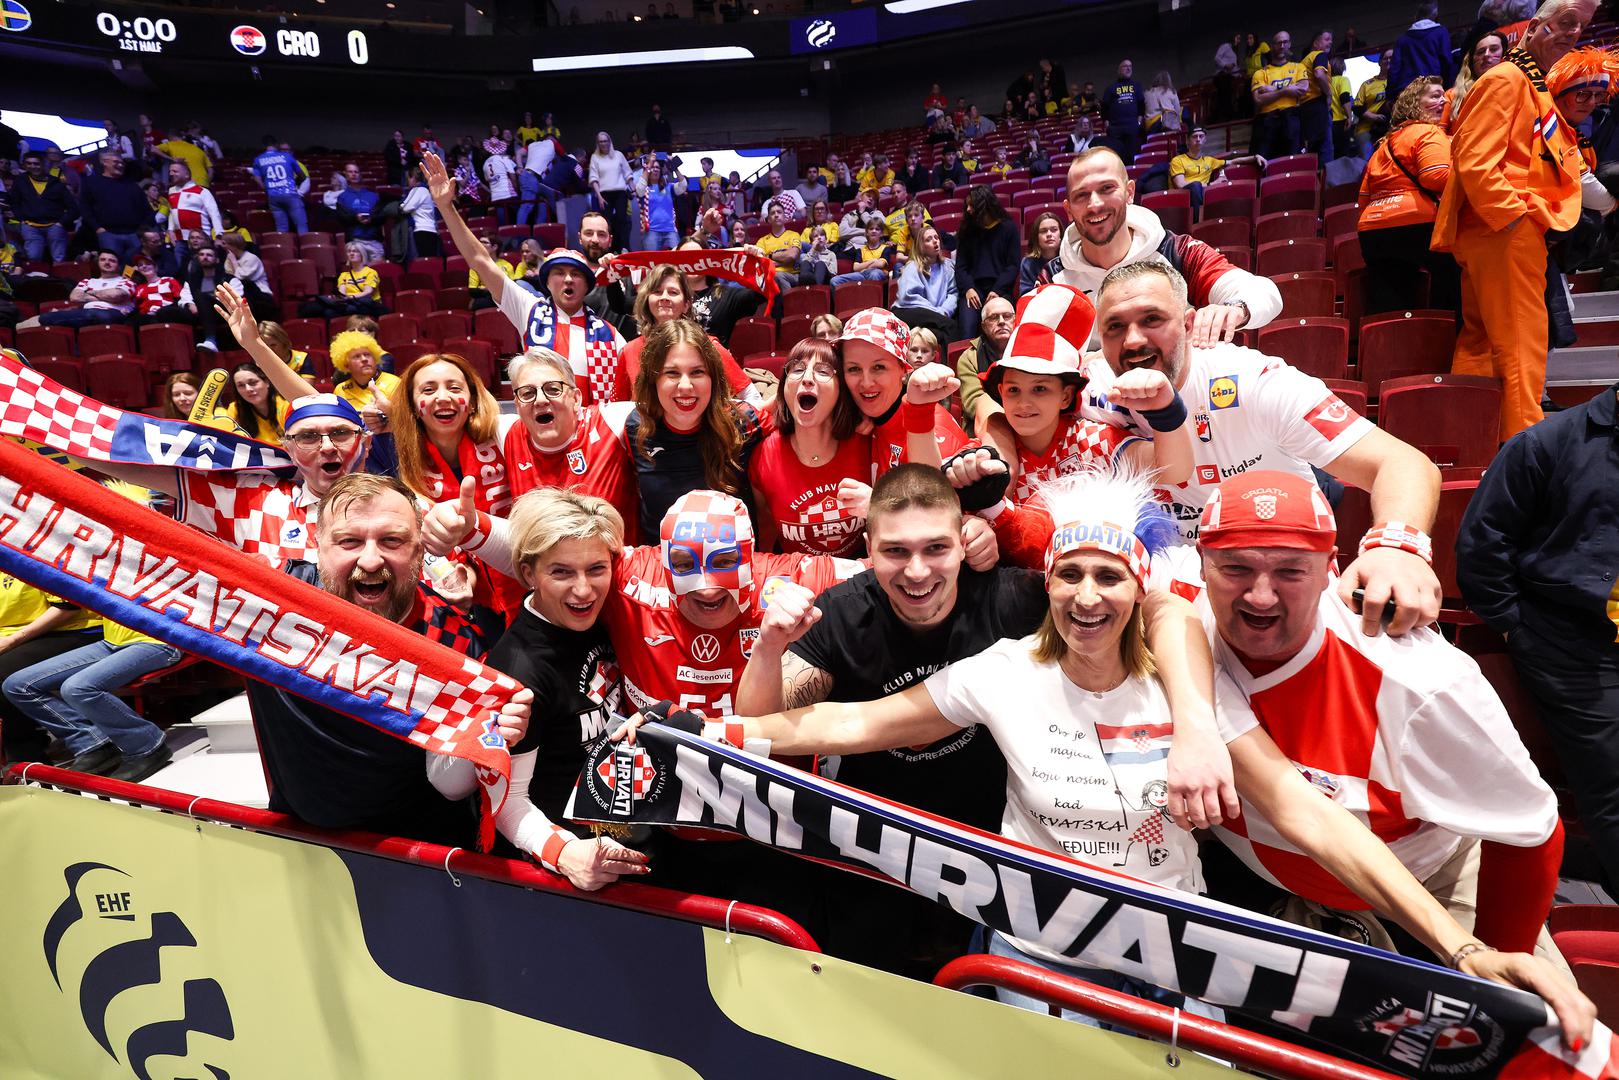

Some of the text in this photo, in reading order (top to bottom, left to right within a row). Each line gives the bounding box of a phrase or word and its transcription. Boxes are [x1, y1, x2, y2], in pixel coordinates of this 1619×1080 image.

[97, 12, 177, 42] 0:00
[119, 38, 162, 53] 1ST HALF
[276, 29, 369, 65] CRO 0
[1116, 85, 1135, 95] SWE
[266, 164, 288, 181] 40
[1211, 387, 1235, 398] LIDL
[1221, 453, 1263, 479] triglav
[789, 489, 815, 511] KLUB
[1240, 487, 1290, 501] CROATIA
[674, 520, 735, 544] CRO
[781, 522, 807, 542] MI
[1053, 524, 1133, 557] CROATIA
[0, 474, 420, 716] HRVATSKA
[579, 663, 590, 694] KLUB
[678, 669, 731, 681] AC Jesenović
[882, 672, 913, 695] KLUB
[1072, 730, 1087, 741] je
[1050, 745, 1094, 760] majica
[611, 756, 632, 817] HRVATI
[1031, 766, 1109, 786] koju nosim
[1053, 797, 1083, 810] kad
[674, 742, 1351, 1034] MI HRVATI
[95, 891, 131, 913] EHF
